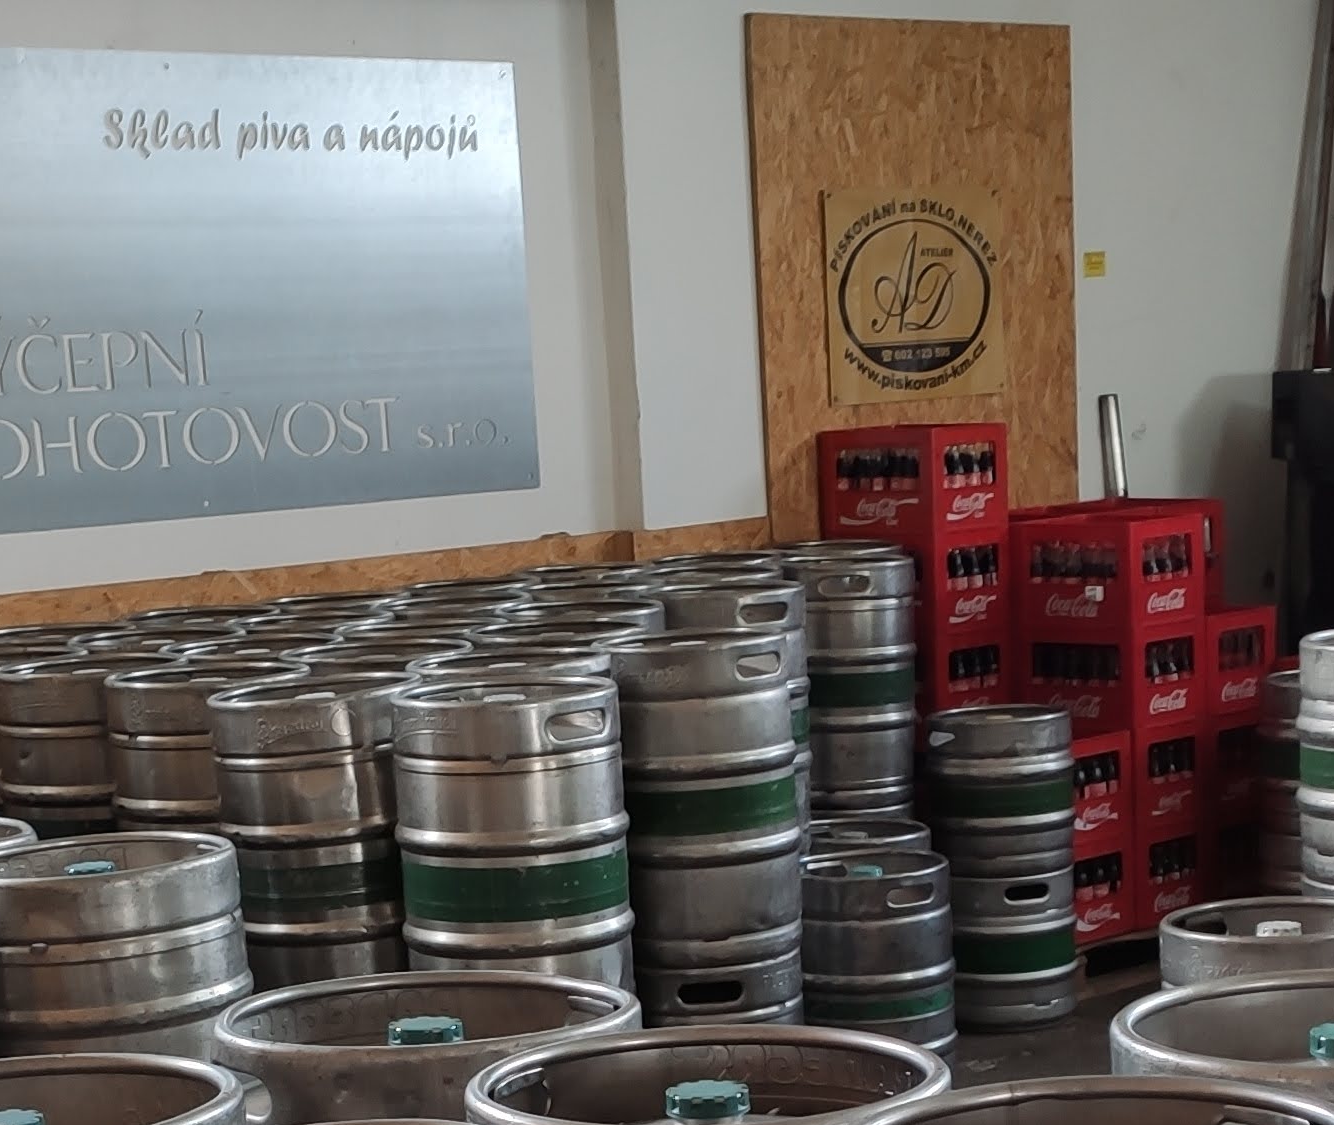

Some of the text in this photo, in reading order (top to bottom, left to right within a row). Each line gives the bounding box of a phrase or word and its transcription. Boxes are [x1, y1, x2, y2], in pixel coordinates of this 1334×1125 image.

[103, 108, 479, 160] Sklad piva a nápojů
